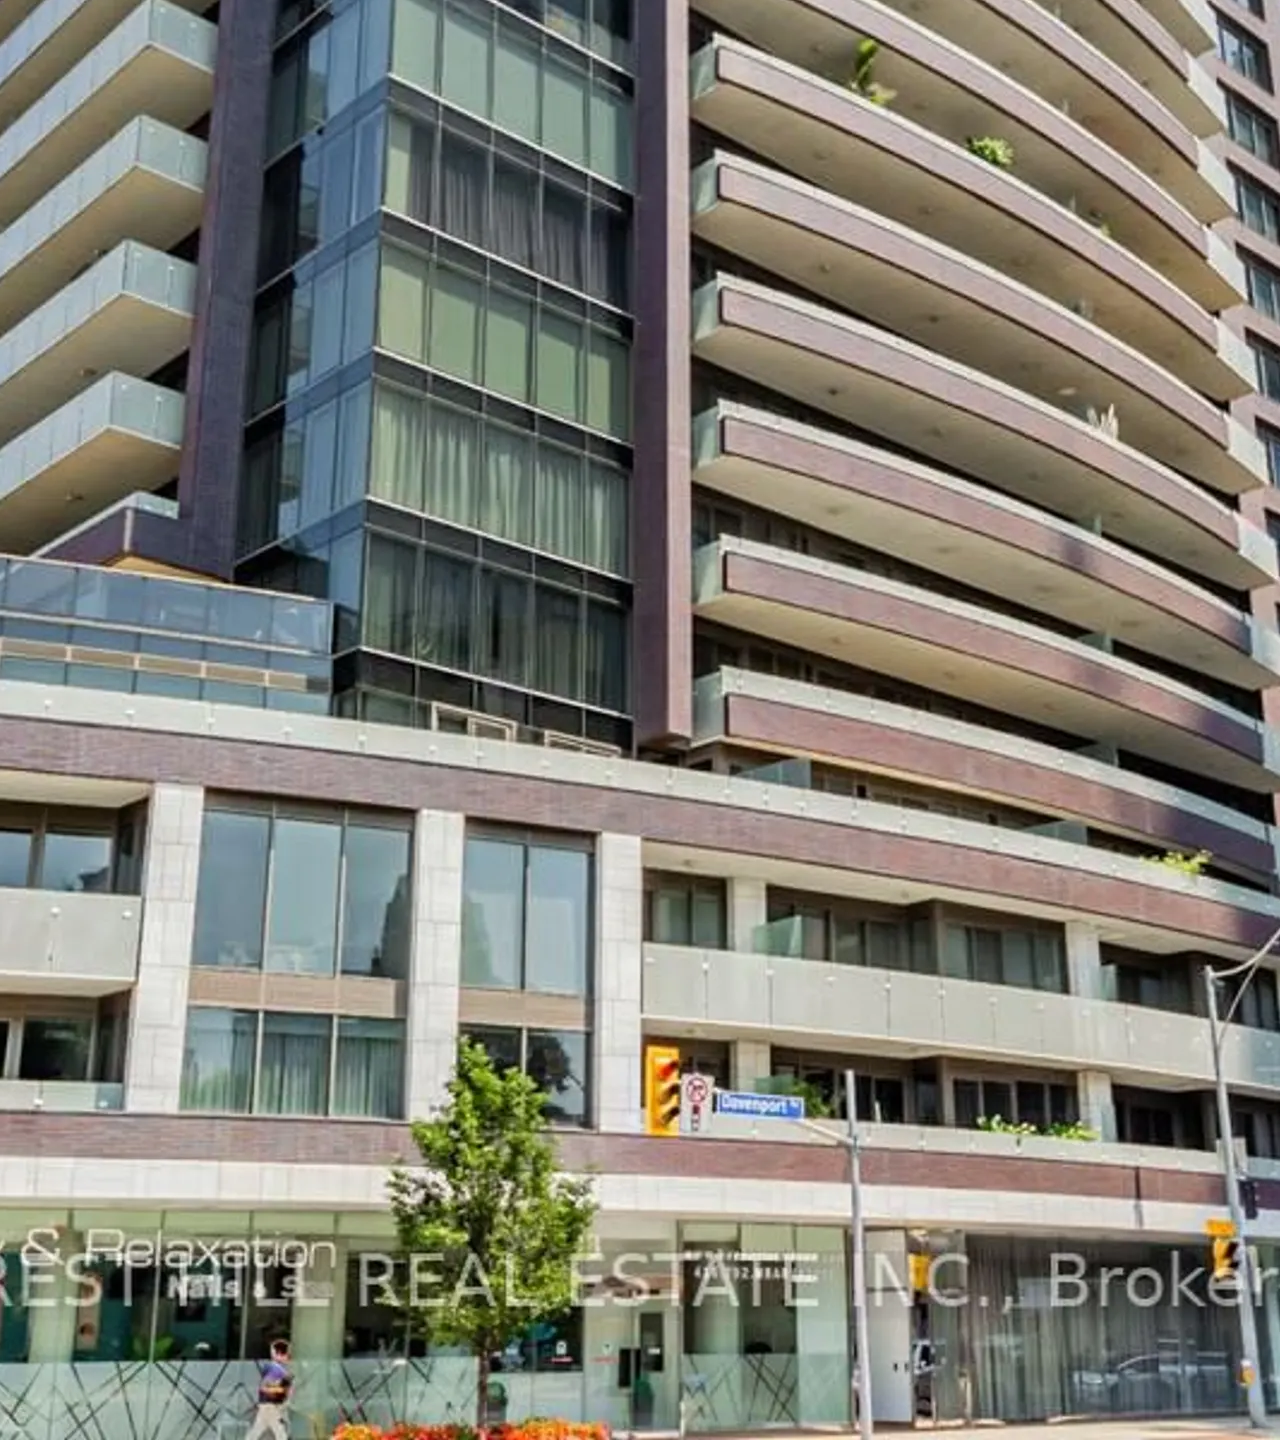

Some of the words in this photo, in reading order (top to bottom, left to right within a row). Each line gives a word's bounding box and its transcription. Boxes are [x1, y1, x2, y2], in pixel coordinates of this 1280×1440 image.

[721, 1094, 789, 1116] Davenport
[21, 1227, 65, 1267] &
[84, 1228, 337, 1269] Relaxation
[169, 1274, 240, 1300] Nails
